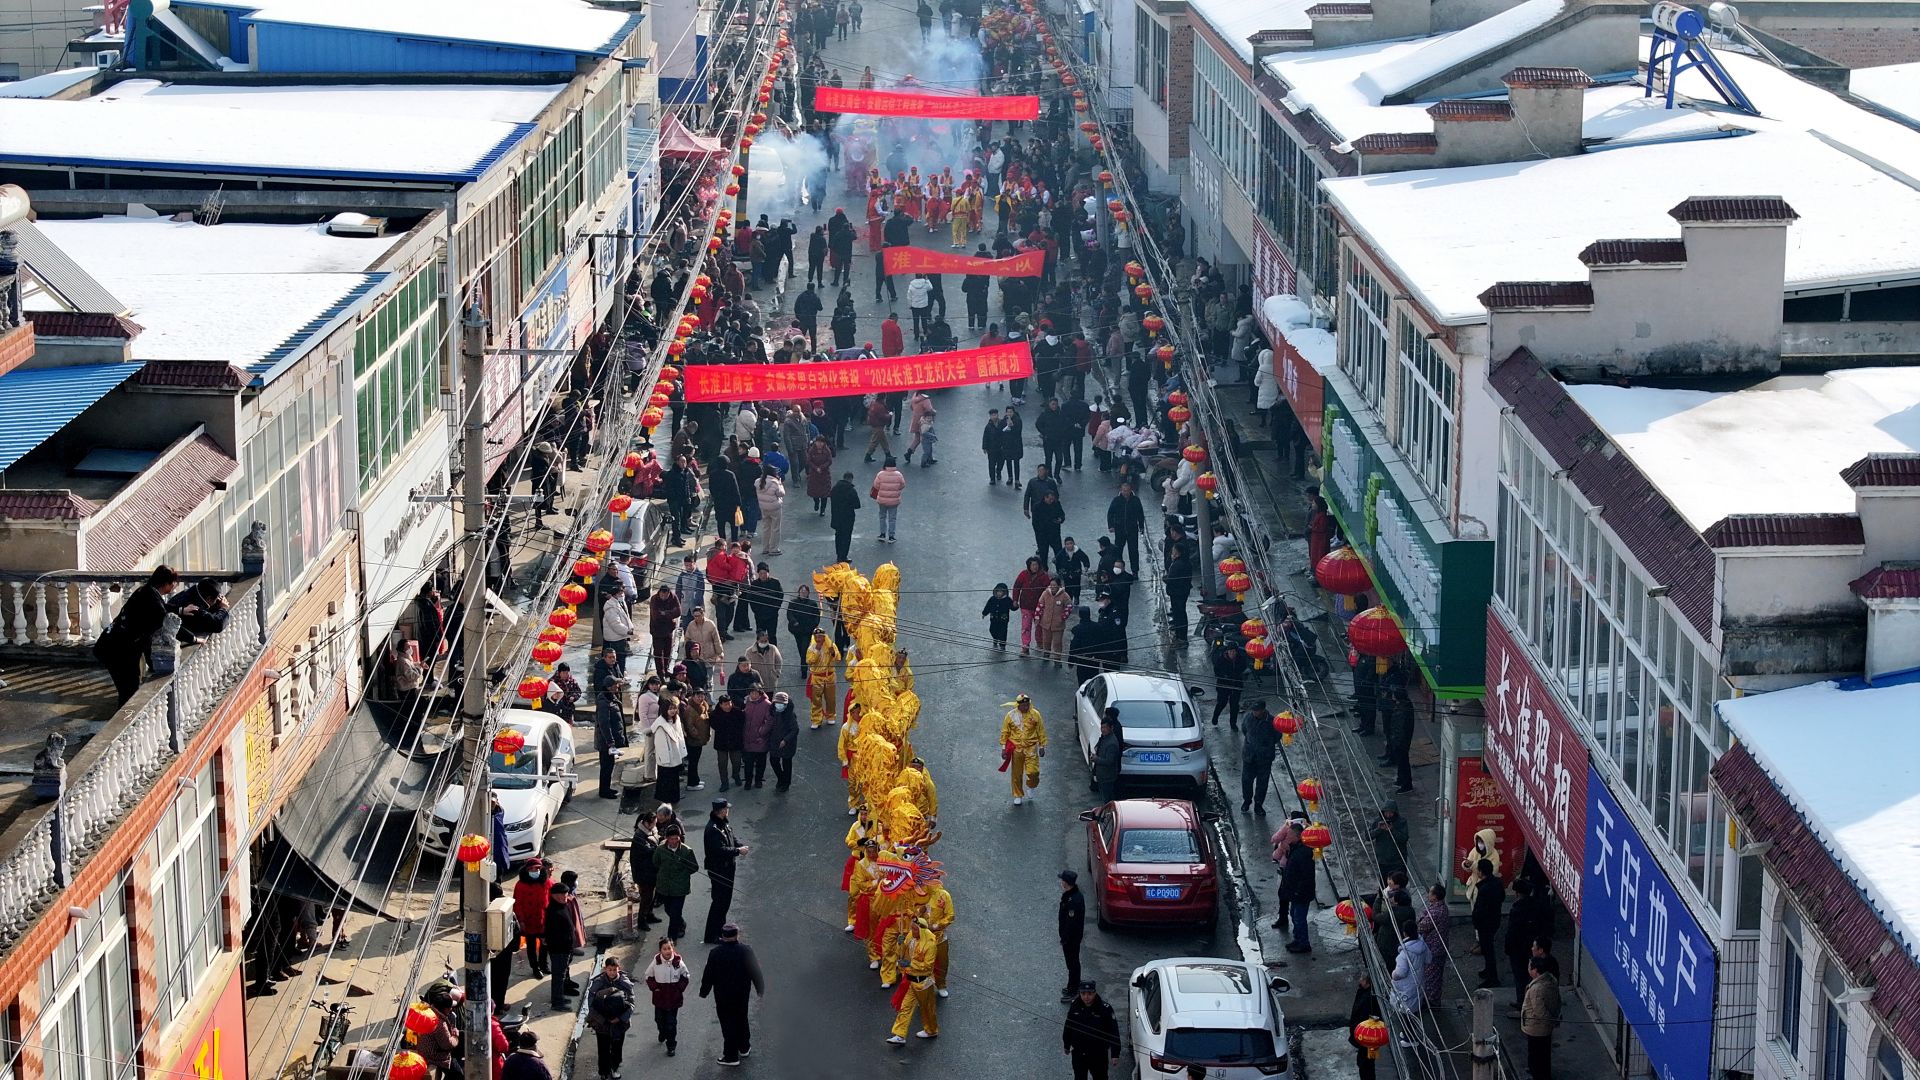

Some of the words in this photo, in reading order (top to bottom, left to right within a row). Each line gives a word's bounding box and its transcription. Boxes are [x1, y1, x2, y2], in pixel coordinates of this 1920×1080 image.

[977, 353, 1020, 377] 圆满成功
[1496, 646, 1571, 840] 长淮照相
[1594, 799, 1697, 1006] 天时地产
[1613, 926, 1665, 1034] 让买房更简单
